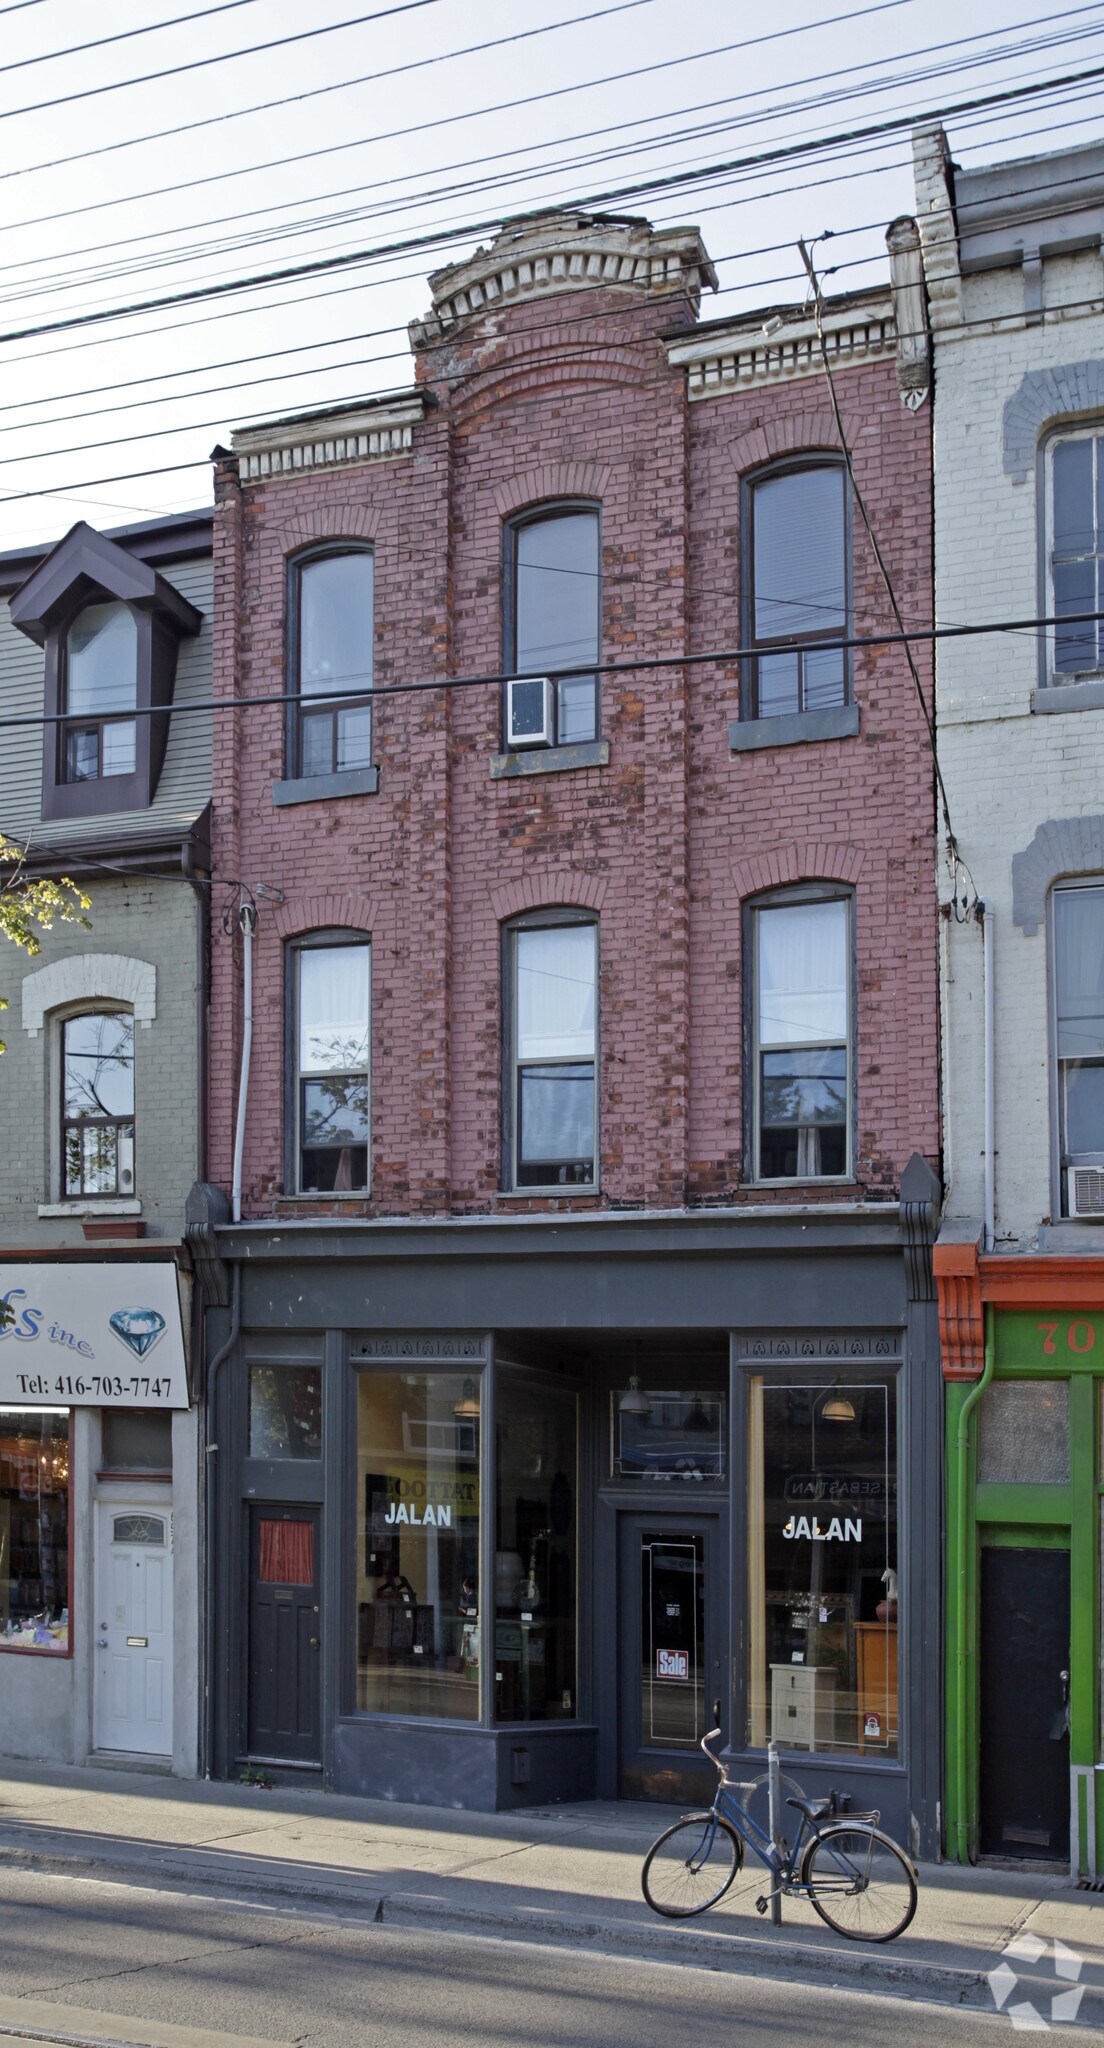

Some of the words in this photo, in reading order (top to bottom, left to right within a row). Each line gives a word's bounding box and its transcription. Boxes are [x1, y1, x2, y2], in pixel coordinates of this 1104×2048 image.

[49, 1321, 95, 1357] inc.
[1037, 1319, 1096, 1355] 70
[16, 1374, 49, 1394] Tel:
[54, 1375, 172, 1398] 416-703-7747
[384, 1502, 452, 1527] JALAN
[782, 1515, 862, 1543] JALAN
[659, 1651, 687, 1677] Sale
